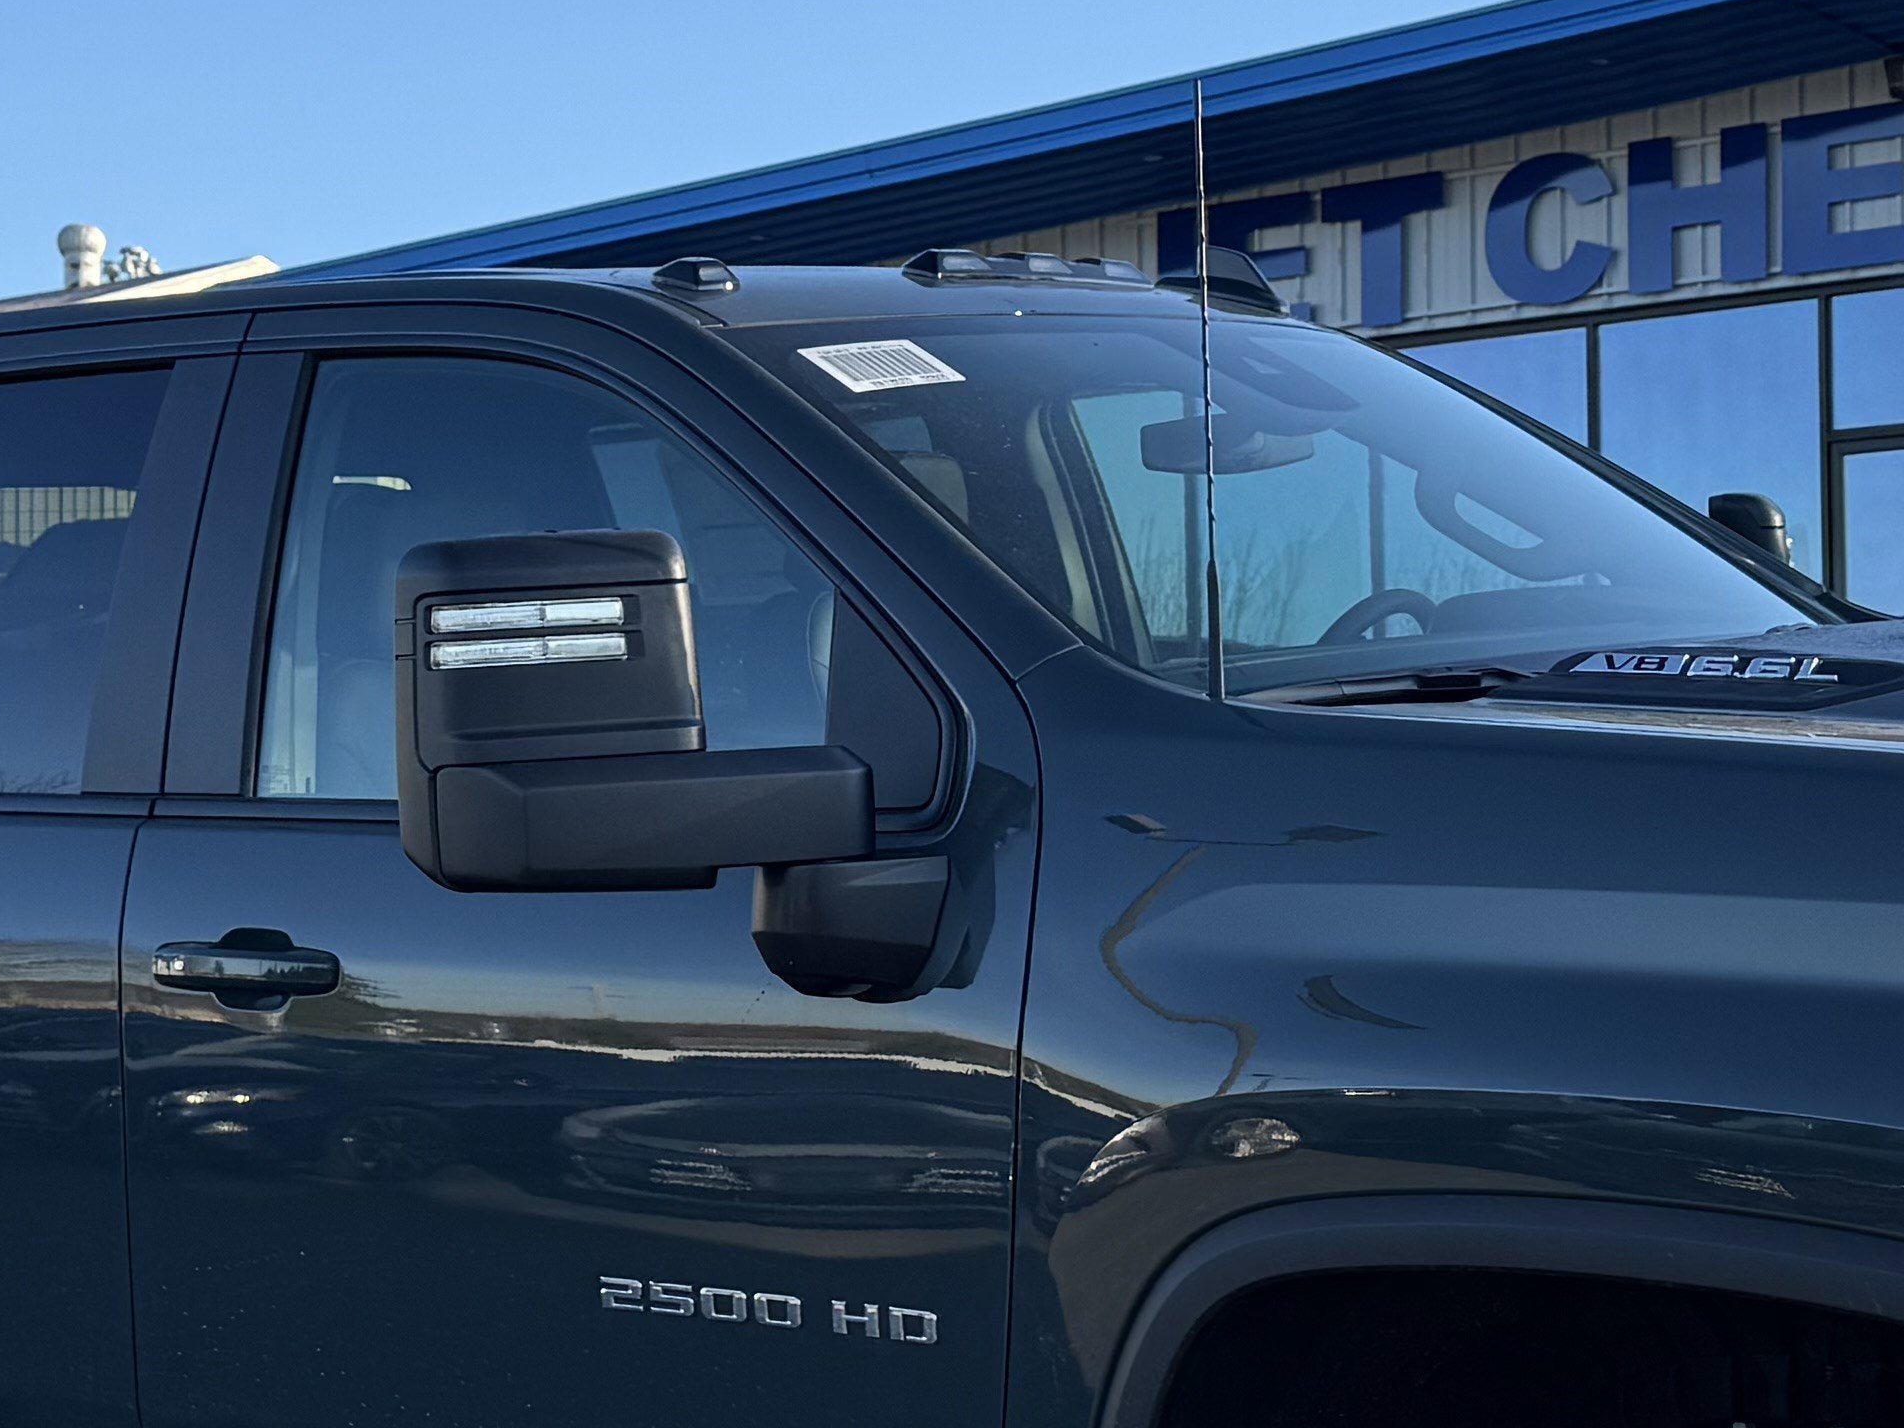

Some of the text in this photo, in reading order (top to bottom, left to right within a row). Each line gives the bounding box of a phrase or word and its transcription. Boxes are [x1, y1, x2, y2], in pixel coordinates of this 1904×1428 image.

[1604, 653, 1839, 682] V8 6.6L
[598, 1275, 938, 1345] 2500 HD
